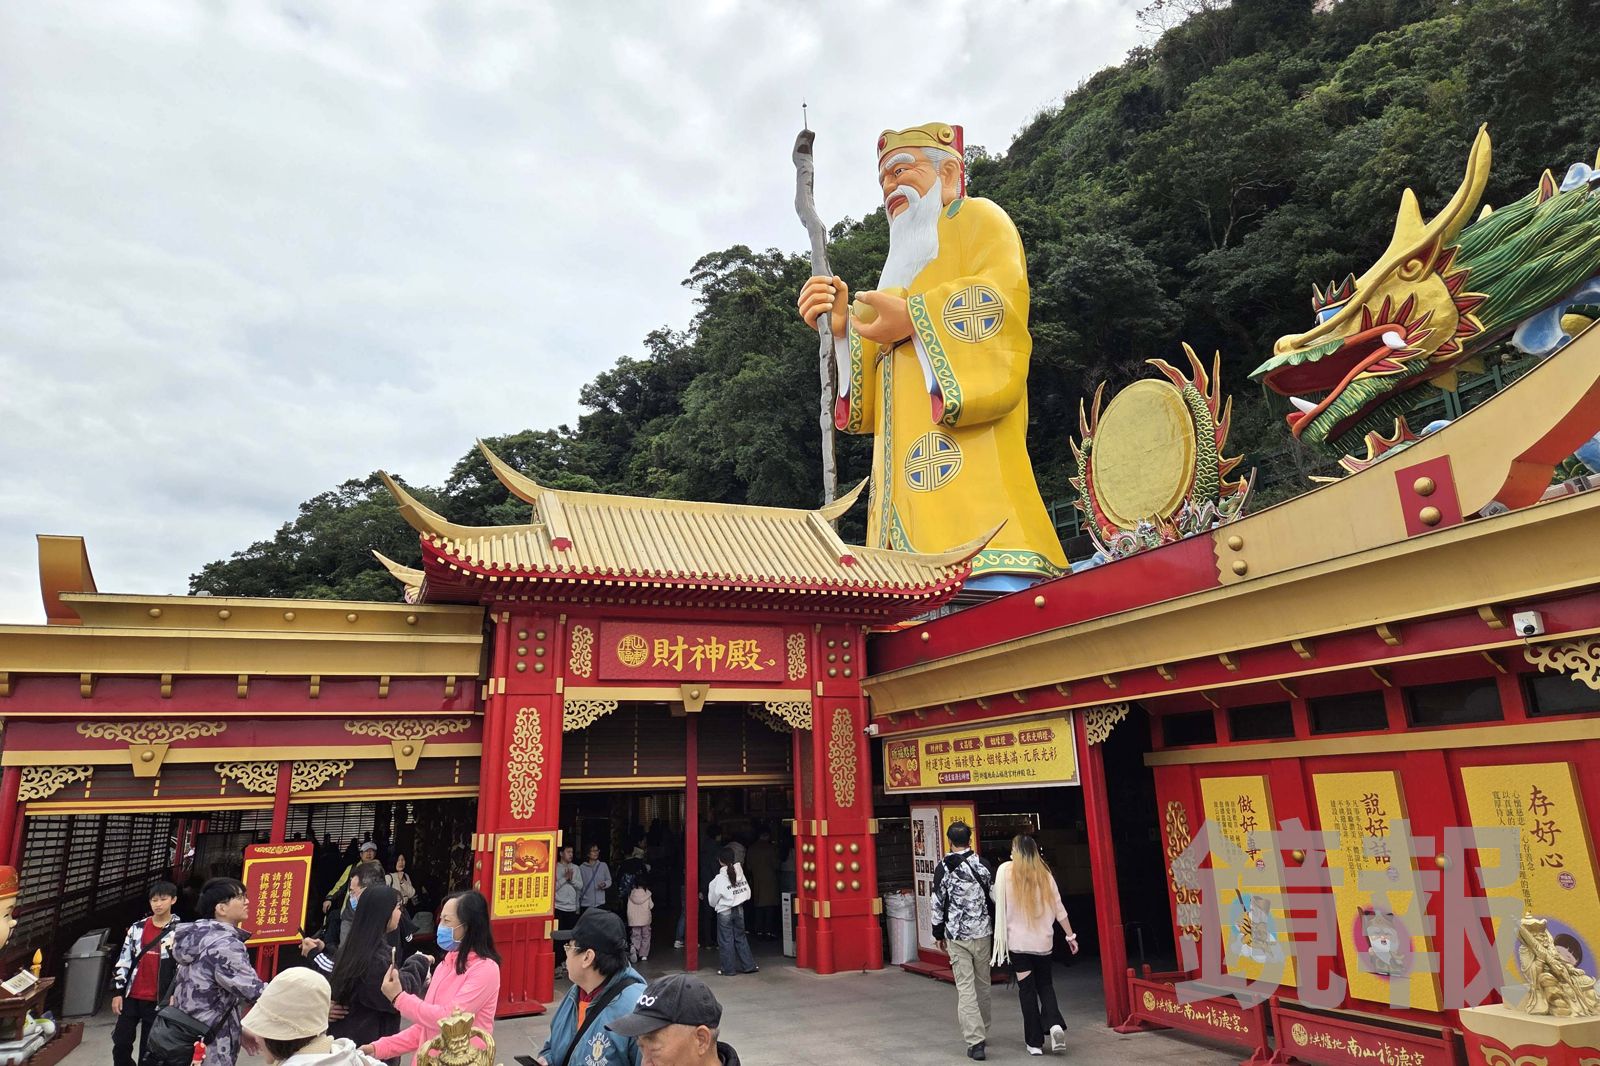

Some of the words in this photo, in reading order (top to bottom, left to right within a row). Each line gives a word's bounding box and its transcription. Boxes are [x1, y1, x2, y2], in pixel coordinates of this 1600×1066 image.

[652, 635, 764, 672] 財神殿
[1238, 795, 1261, 861] 做好事
[1361, 792, 1392, 865] 說好話
[1528, 784, 1564, 869] 存好心
[267, 872, 282, 925] 請勿亂丟垃圾
